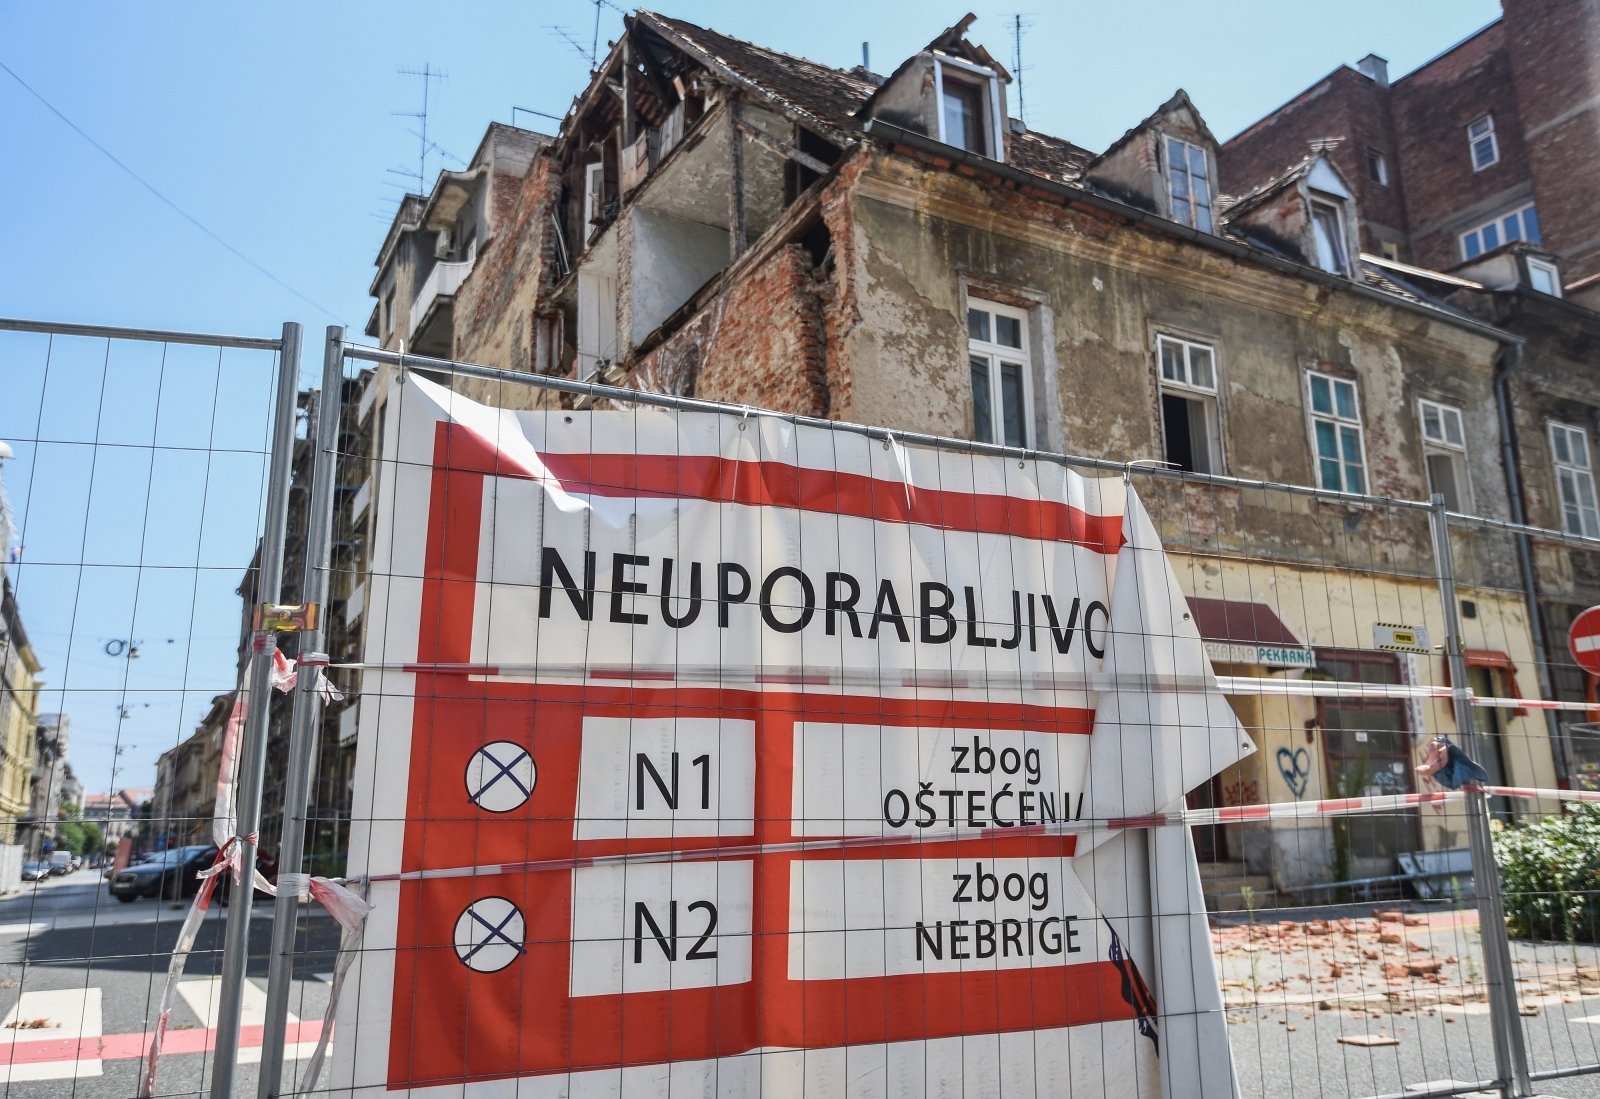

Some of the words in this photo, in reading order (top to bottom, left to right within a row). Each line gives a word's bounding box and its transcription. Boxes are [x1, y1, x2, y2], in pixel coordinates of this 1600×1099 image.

[537, 546, 1110, 660] NEUPORABLJIVO
[1205, 643, 1255, 661] EKARNA
[1259, 648, 1313, 664] PEKARNA
[636, 752, 710, 810] N1
[950, 735, 1042, 785] zbog
[952, 862, 1049, 911] zbog
[634, 900, 718, 963] N2
[915, 915, 1081, 961] NEBRIGE
